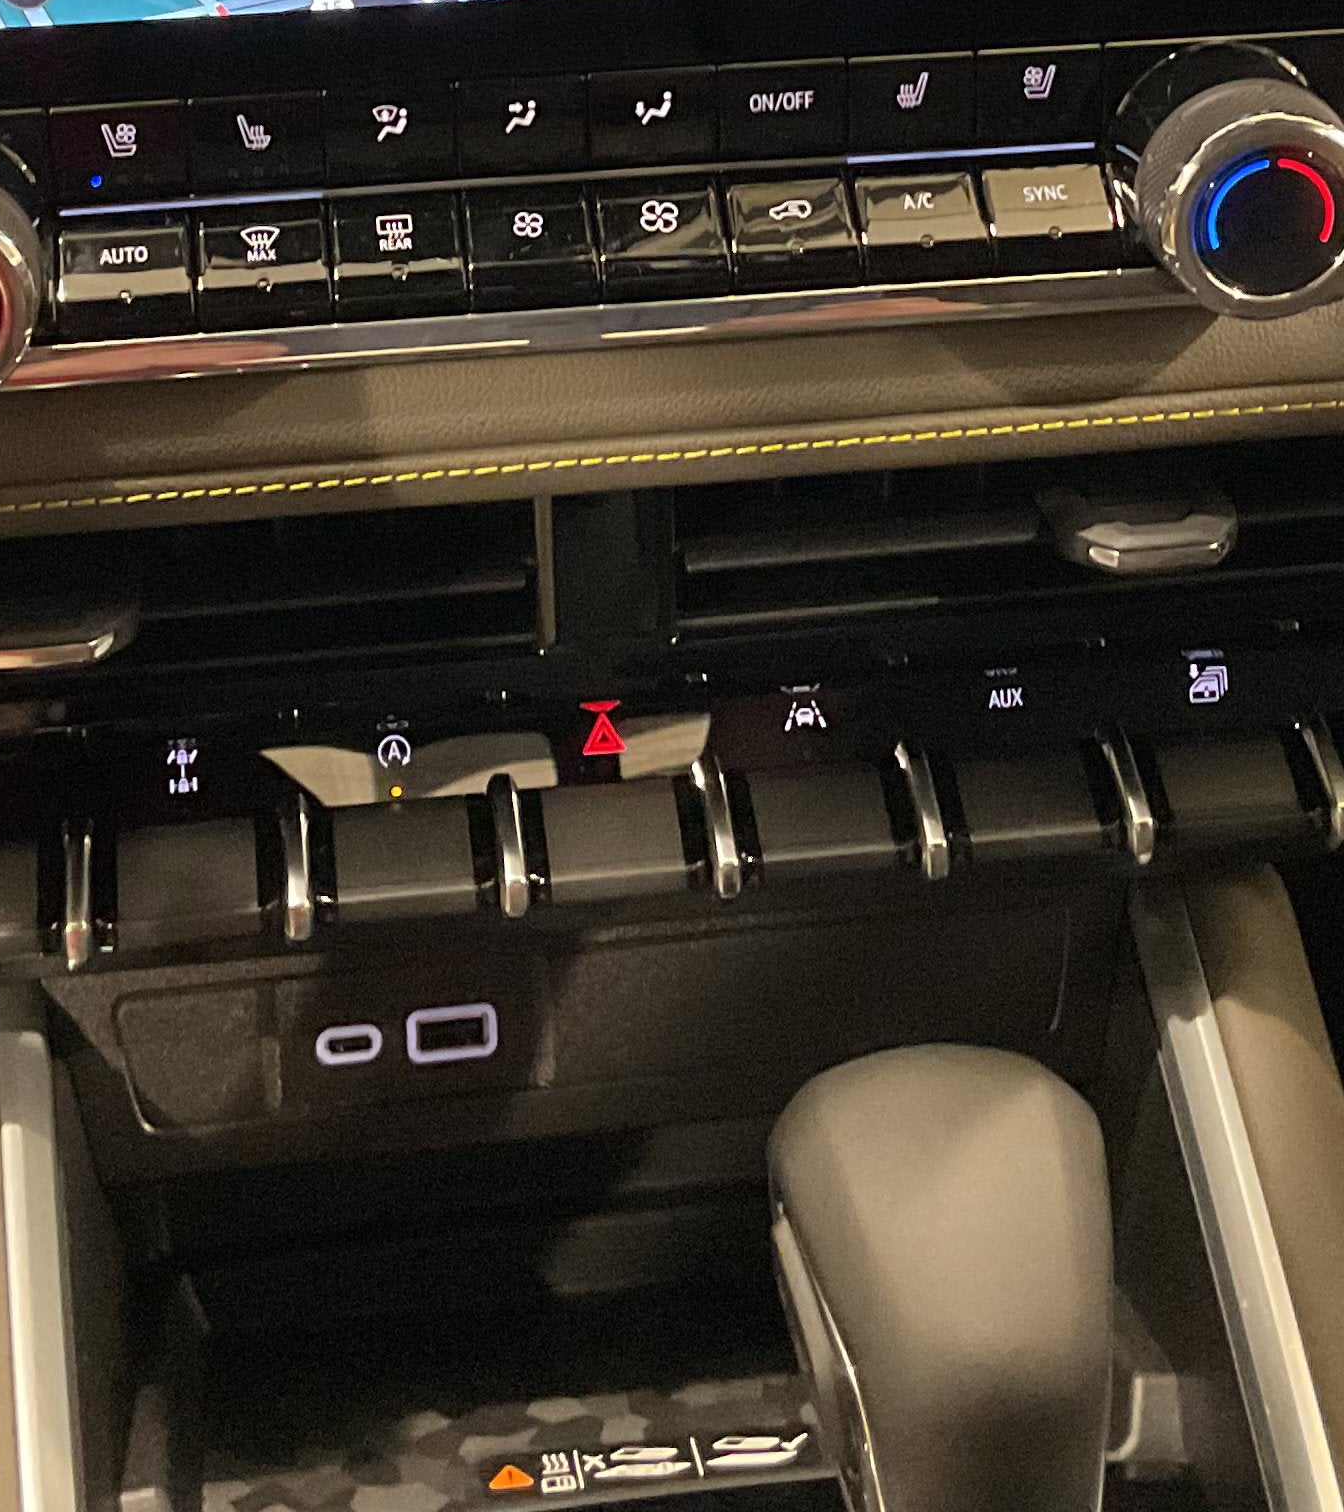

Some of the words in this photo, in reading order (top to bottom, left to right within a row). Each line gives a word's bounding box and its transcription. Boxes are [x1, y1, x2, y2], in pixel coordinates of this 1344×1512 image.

[749, 90, 814, 113] ON/OFF
[903, 191, 935, 210] A/C
[1023, 183, 1068, 203] SYNC
[99, 245, 148, 265] AUTO
[379, 238, 412, 252] REAR
[246, 248, 276, 263] MAX
[988, 686, 1024, 710] AUX
